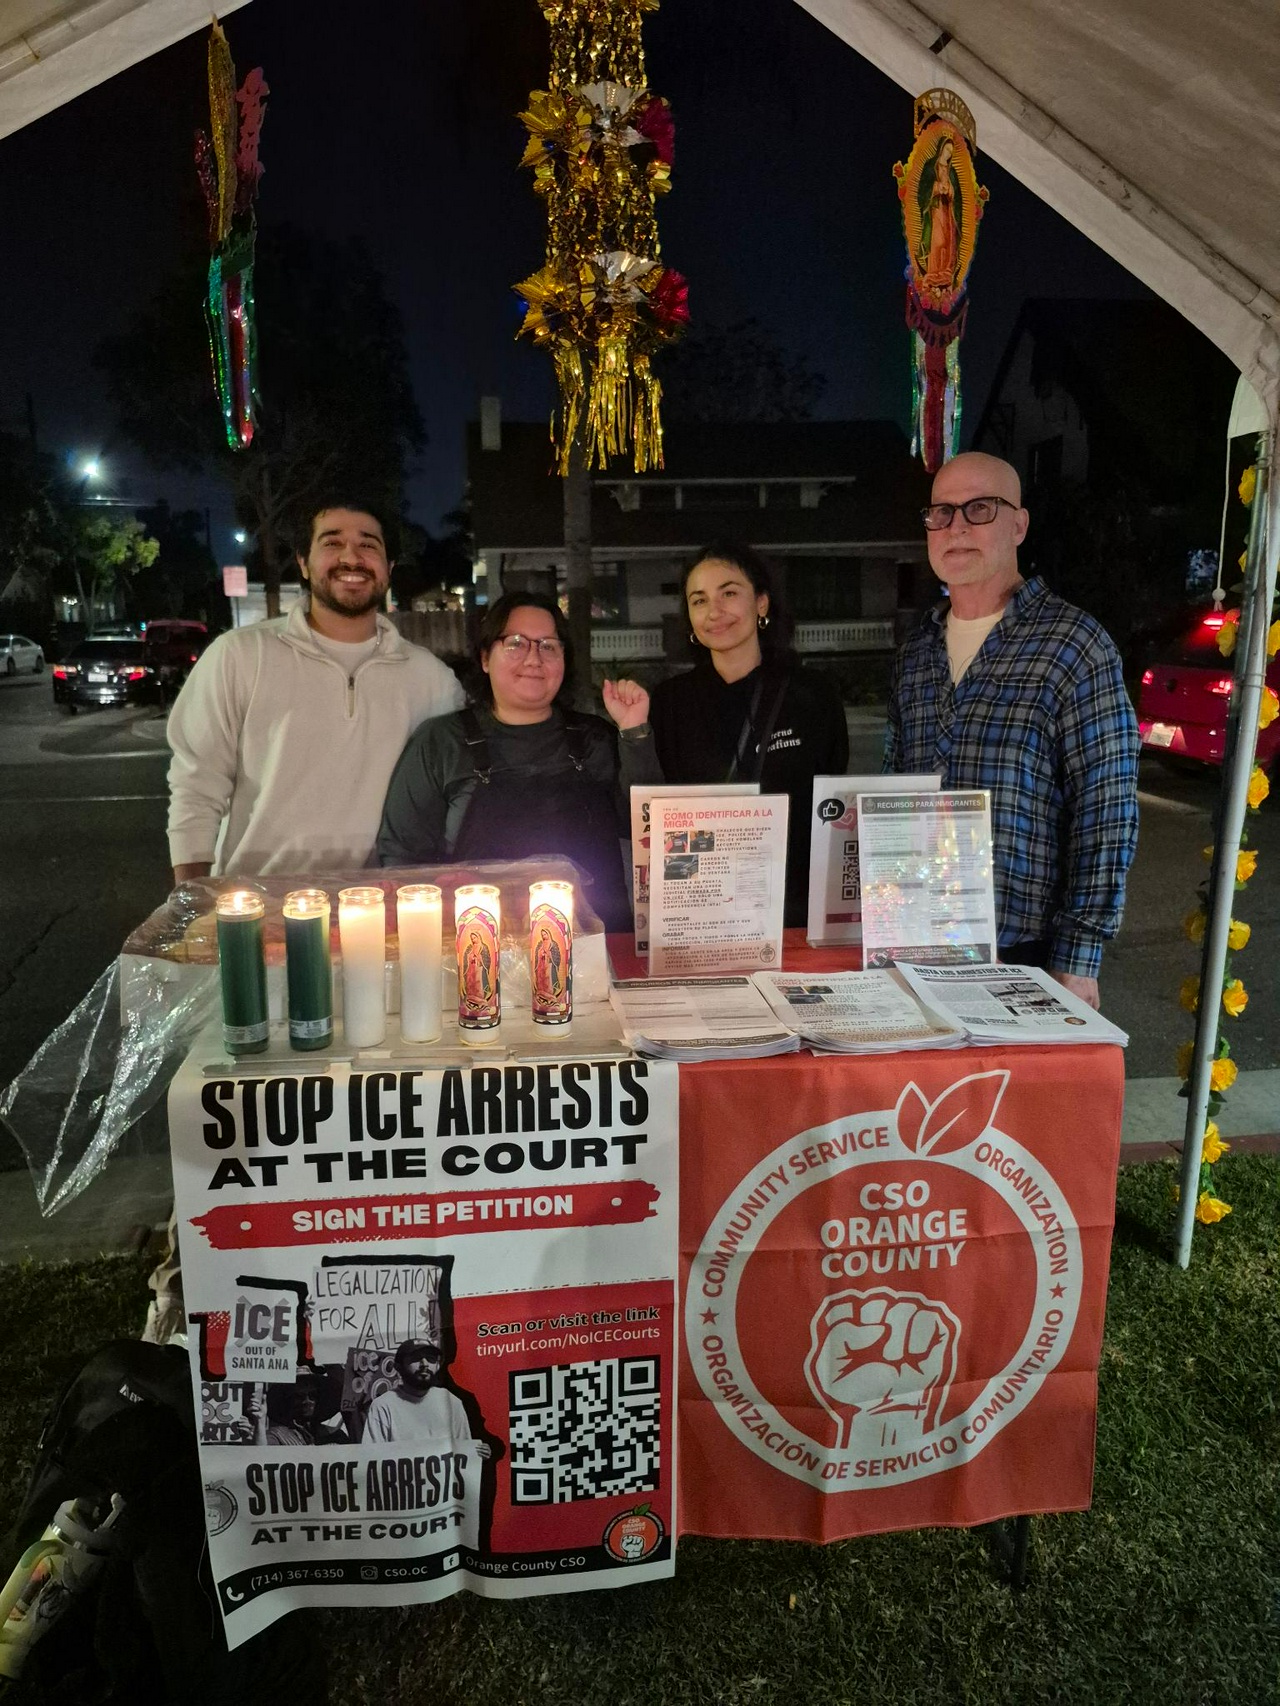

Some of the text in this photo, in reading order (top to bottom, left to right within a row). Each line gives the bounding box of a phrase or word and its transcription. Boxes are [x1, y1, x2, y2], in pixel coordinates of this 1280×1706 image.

[756, 738, 802, 754] Cations
[664, 812, 694, 820] COMO
[696, 810, 752, 819] IDENTIFICAR
[762, 809, 772, 817] LA
[877, 800, 982, 810] RECURSOS PARA INMIGRANTES
[664, 820, 694, 828] MIGRA
[913, 967, 938, 976] BASTA
[201, 1060, 650, 1150] STOP ICE ARRESTS
[207, 1134, 648, 1190] AT THE COURT
[859, 1179, 931, 1211] CSO
[292, 1195, 574, 1233] SIGN THE PETITION
[702, 1126, 1069, 1298] COMMUNITY SERVICE ORGANIZATION
[820, 1208, 968, 1249] ORANGE
[821, 1240, 967, 1279] COUNTY
[315, 1266, 441, 1298] LEGALIZATION
[233, 1302, 292, 1343] ICE
[319, 1306, 358, 1332] FOR
[476, 1306, 660, 1338] Scan or visit the link
[245, 1346, 276, 1356] OUT OF
[476, 1326, 661, 1358] tinyurl.com/NoICECourts
[231, 1356, 289, 1370] SANTA ANA
[201, 1382, 244, 1402] OUT
[701, 1308, 1064, 1480] ORGANIZACIÓN DE SERVICIO COMUNITARIO
[200, 1421, 242, 1441] RTS
[246, 1452, 468, 1516] STOP ICE ARRESTS
[251, 1512, 466, 1546] AT THE COURT
[250, 1571, 284, 1590] (714)
[286, 1568, 344, 1580] 367-6350
[384, 1566, 429, 1577] cso.oc
[465, 1556, 509, 1574] Orange
[512, 1559, 556, 1574] County
[559, 1556, 586, 1568] CSO
